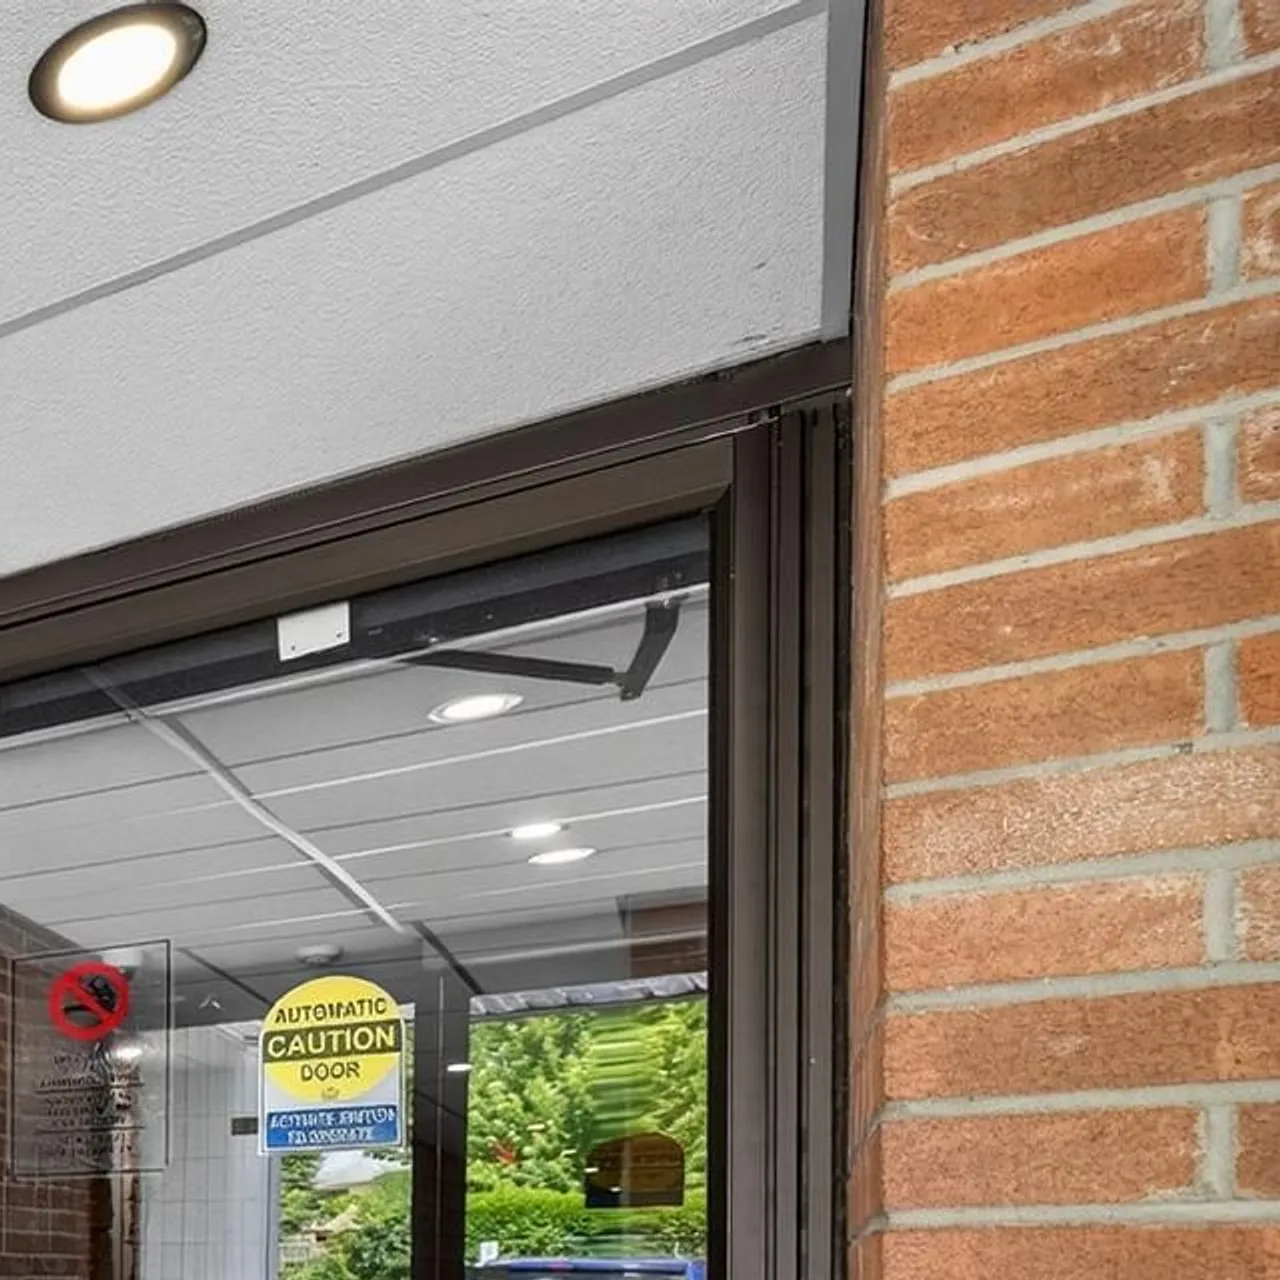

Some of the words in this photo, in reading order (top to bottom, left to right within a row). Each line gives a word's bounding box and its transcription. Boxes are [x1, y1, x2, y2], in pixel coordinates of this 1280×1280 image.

[274, 997, 388, 1024] AUTOMATIC
[267, 1025, 395, 1058] CAUTION
[300, 1061, 361, 1082] DOOR
